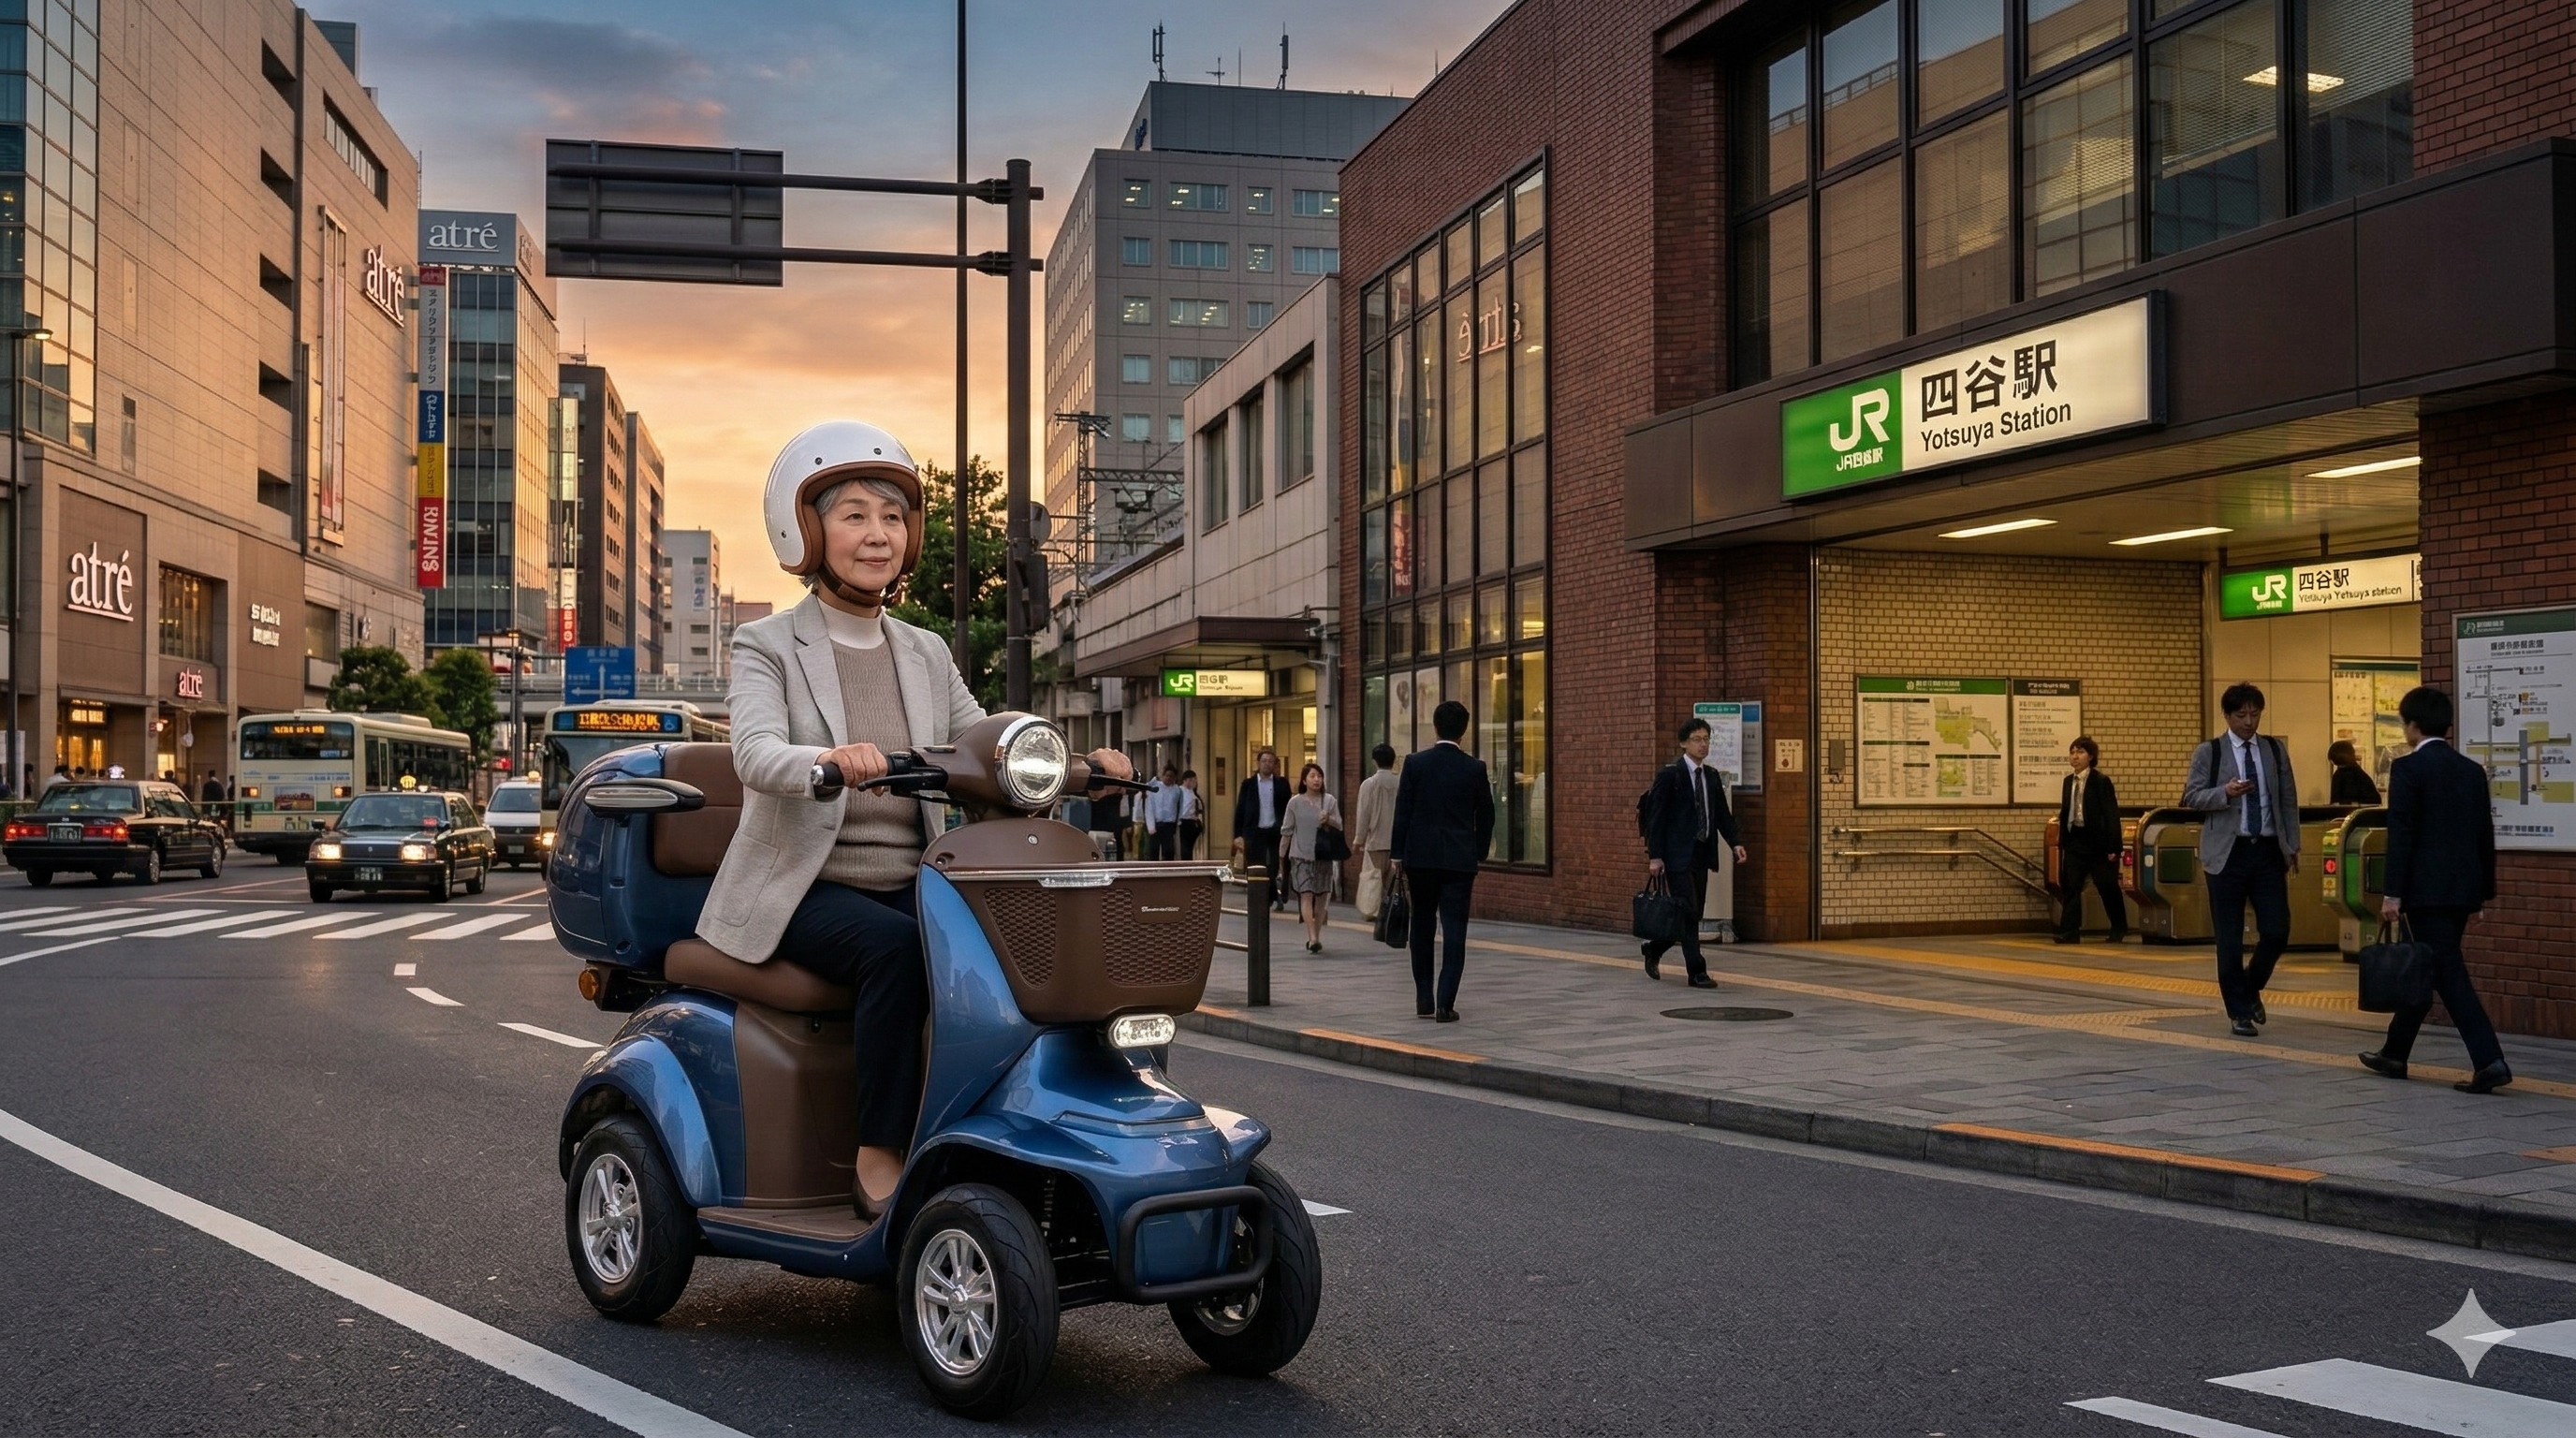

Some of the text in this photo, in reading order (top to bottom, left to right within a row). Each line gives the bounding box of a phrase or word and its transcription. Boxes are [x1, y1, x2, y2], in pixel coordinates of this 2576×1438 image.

[429, 220, 498, 250] atré
[366, 244, 404, 321] atré
[1921, 340, 2058, 422] 四谷駅
[1829, 388, 1891, 452] JR
[1921, 403, 2071, 452] Yotsuya Station
[70, 541, 133, 615] atré
[2251, 574, 2288, 602] JR
[2299, 567, 2349, 592] 四谷駅
[178, 668, 203, 695] atré
[1170, 674, 1194, 687] JR
